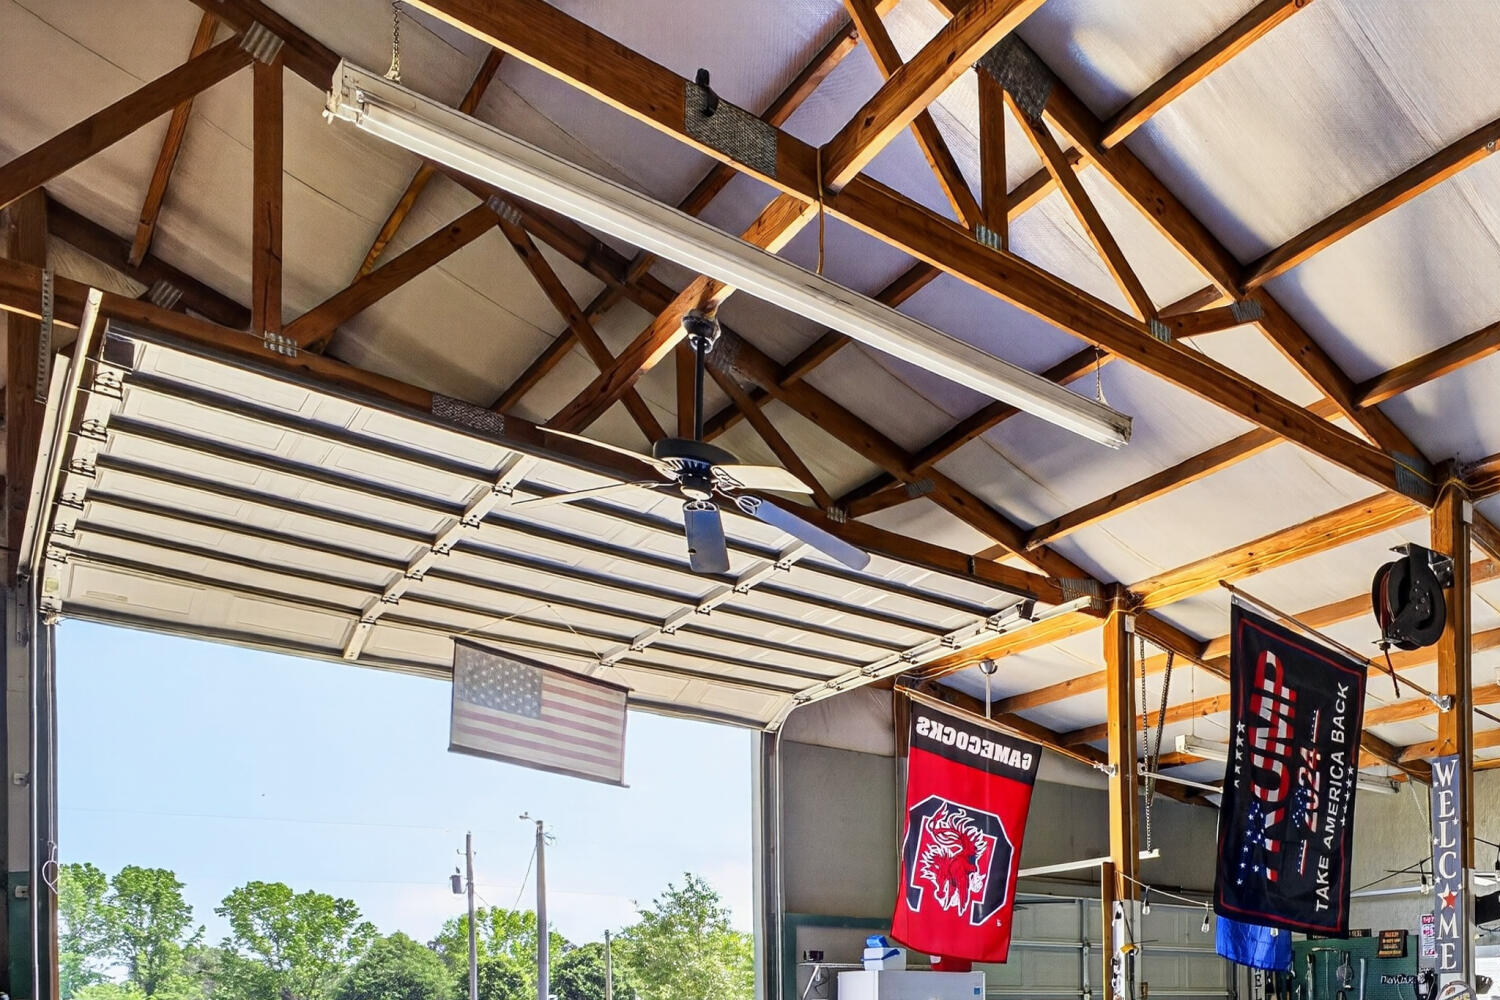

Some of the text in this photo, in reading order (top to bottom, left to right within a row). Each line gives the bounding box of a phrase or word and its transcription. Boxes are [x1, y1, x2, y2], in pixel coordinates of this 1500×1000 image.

[1236, 650, 1298, 888] TRUMP
[1293, 746, 1322, 833] 2024
[1316, 682, 1350, 912] TAKE AMERICA BACK
